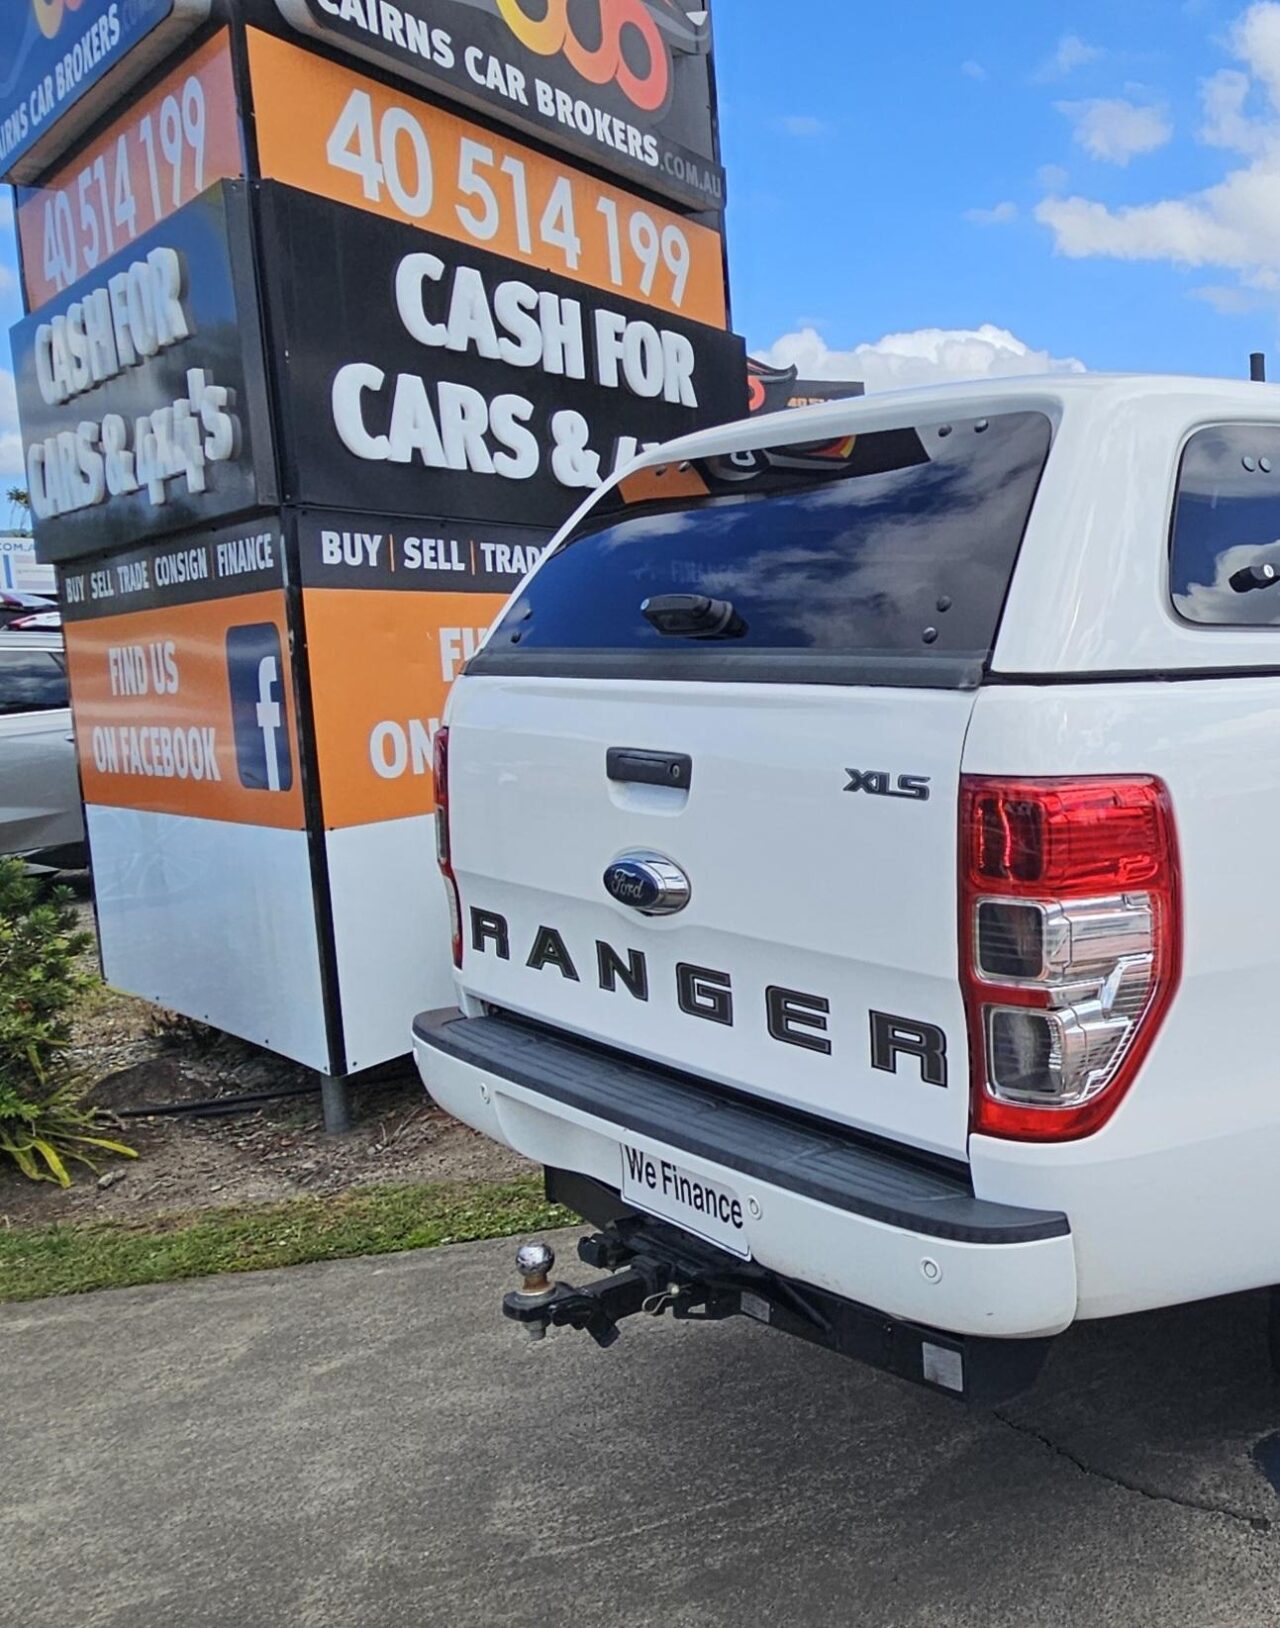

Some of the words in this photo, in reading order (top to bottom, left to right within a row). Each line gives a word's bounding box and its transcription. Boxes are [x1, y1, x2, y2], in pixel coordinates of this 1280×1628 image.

[30, 75, 55, 126] CAR
[465, 46, 529, 106] CAR
[44, 190, 78, 292] 40
[78, 134, 137, 270] 514
[139, 75, 205, 222] 199
[326, 88, 434, 218] 40
[454, 136, 581, 271] 514
[596, 195, 690, 308] 199
[34, 288, 120, 405] CASH
[108, 247, 189, 368] FOR
[394, 252, 586, 380] CASH
[594, 308, 698, 408] FOR
[331, 362, 540, 480] CARS
[551, 409, 603, 489] &
[27, 421, 105, 519] CARS
[101, 413, 139, 496] &
[66, 574, 84, 603] BUY
[91, 570, 114, 599] SELL
[117, 561, 149, 593] TRADE
[154, 547, 208, 587] CONSIGN
[216, 532, 274, 578] FINANCE
[320, 530, 382, 567] BUY
[403, 536, 465, 571] SELL
[480, 542, 548, 573] TRAD
[108, 645, 149, 696] FIND
[150, 640, 180, 695] US
[92, 726, 120, 773] ON
[119, 726, 222, 782] FACEBOOK
[369, 717, 441, 779] ON
[842, 767, 932, 802] XLS
[611, 868, 645, 900] Ford
[470, 905, 949, 1088] RANGER
[625, 1144, 657, 1189] We
[661, 1160, 744, 1229] Finance
